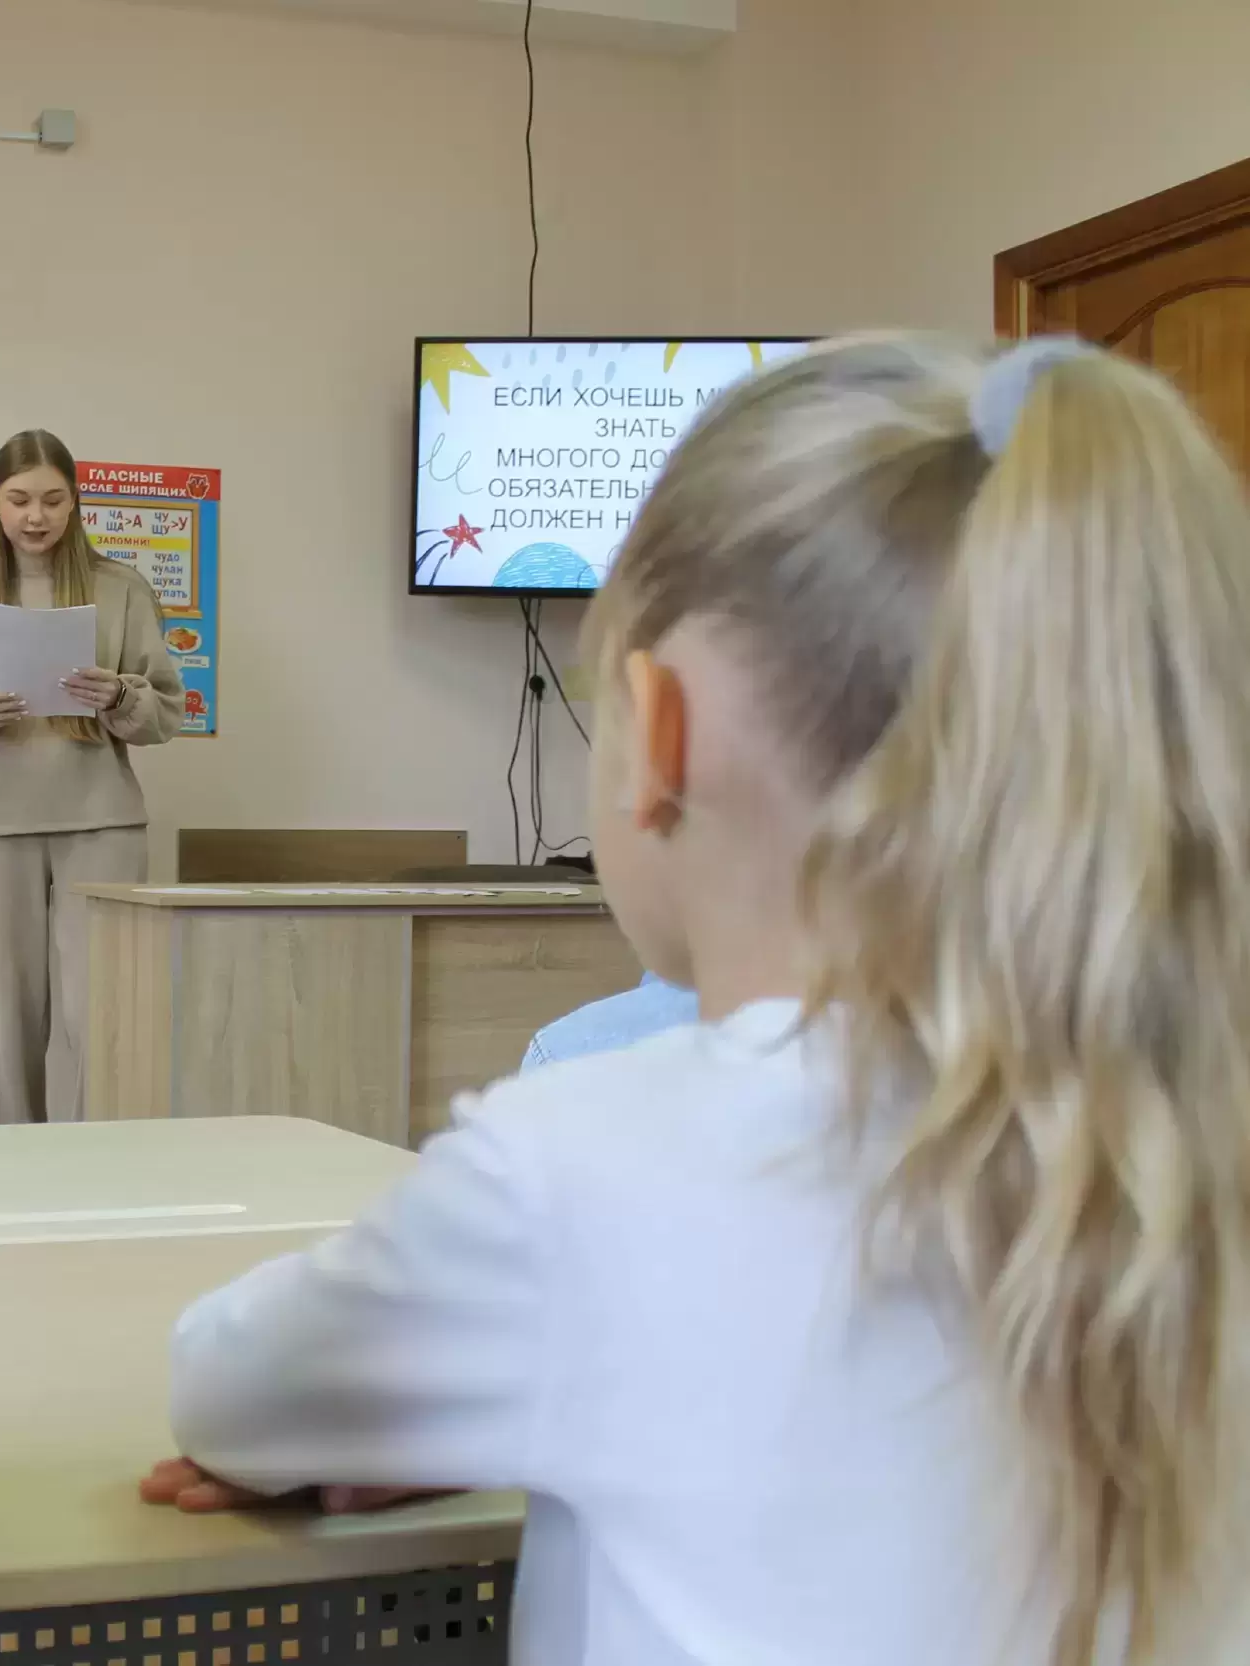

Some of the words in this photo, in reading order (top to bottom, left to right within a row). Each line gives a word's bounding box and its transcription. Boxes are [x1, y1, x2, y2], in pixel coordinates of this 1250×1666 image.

[494, 387, 562, 407] ЕСЛИ
[573, 387, 684, 407] ХОЧЕШЬ
[497, 448, 621, 468] МНОГОГО
[630, 449, 669, 472] ДО
[88, 468, 164, 484] ГЛАСНЫЕ
[80, 483, 113, 493] ОСЛЕ
[119, 484, 187, 497] ШИПЯЩИХ
[488, 478, 654, 499] ОБЯЗАТЕЛЬН
[109, 510, 123, 520] ЧА
[154, 512, 169, 523] ЧУ
[490, 509, 603, 532] ДОЛЖЕН
[615, 510, 632, 530] Н
[97, 536, 150, 546] ЗАПОМНИ!
[155, 552, 180, 563] чудо
[152, 564, 183, 575] чулан
[153, 578, 182, 588] щука
